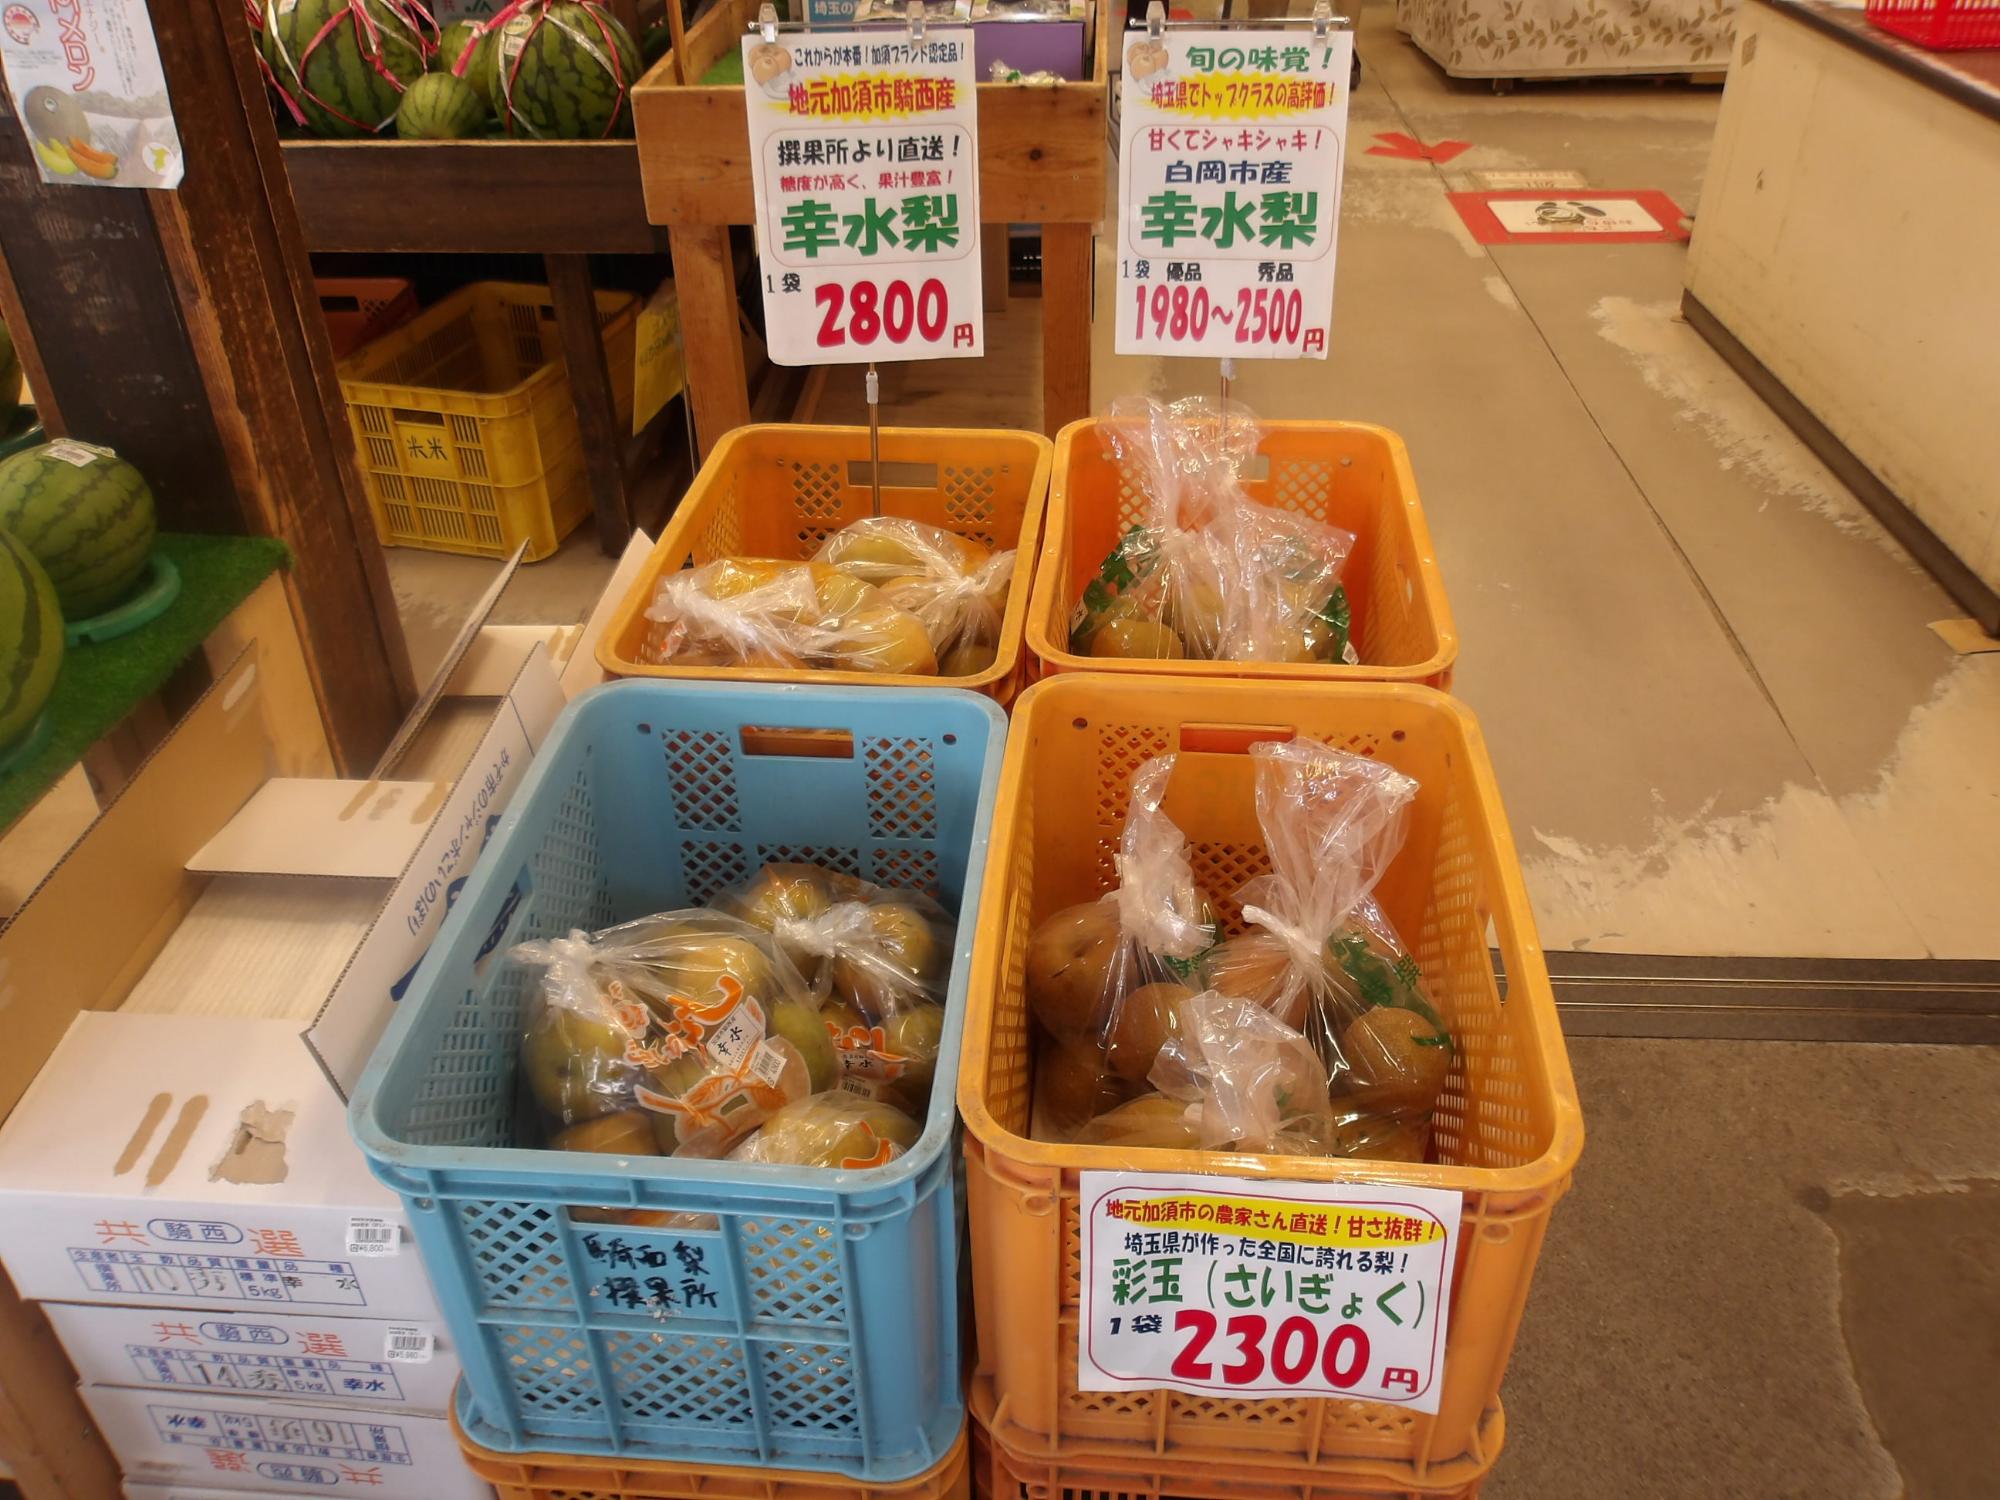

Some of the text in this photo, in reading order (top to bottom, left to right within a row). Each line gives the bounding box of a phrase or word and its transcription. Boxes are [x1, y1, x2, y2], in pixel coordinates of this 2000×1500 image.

[814, 1, 860, 16] 埼玉の
[1186, 46, 1333, 72] 旬の味覚！
[788, 78, 956, 115] 地元加須市騎西産
[1151, 81, 1335, 110] 埼玉県でトップクラスの高評価！
[777, 135, 960, 166] 撰果所より直送！
[1148, 128, 1322, 151] 甘くてシャキシャキ！
[780, 170, 953, 192] 糖度が高く、果汁豊富！
[1165, 160, 1292, 184] 白岡市産
[781, 193, 960, 258] 幸水梨
[1140, 190, 1318, 249] 幸水梨
[1166, 262, 1202, 282] 優品
[1258, 262, 1294, 282] 秀品
[815, 278, 975, 348] 2800円
[717, 1026, 743, 1056] 幸水
[1106, 1199, 1437, 1242] 地元加須市の農家さん直送！甘さ抜群！
[94, 1220, 305, 1257] 共 騎西 選
[1124, 1231, 1409, 1276] 埼玉県が作った全国に誇れる梨！
[248, 1285, 284, 1299] 5kg
[152, 1321, 204, 1345] 共
[295, 1331, 349, 1357] 選
